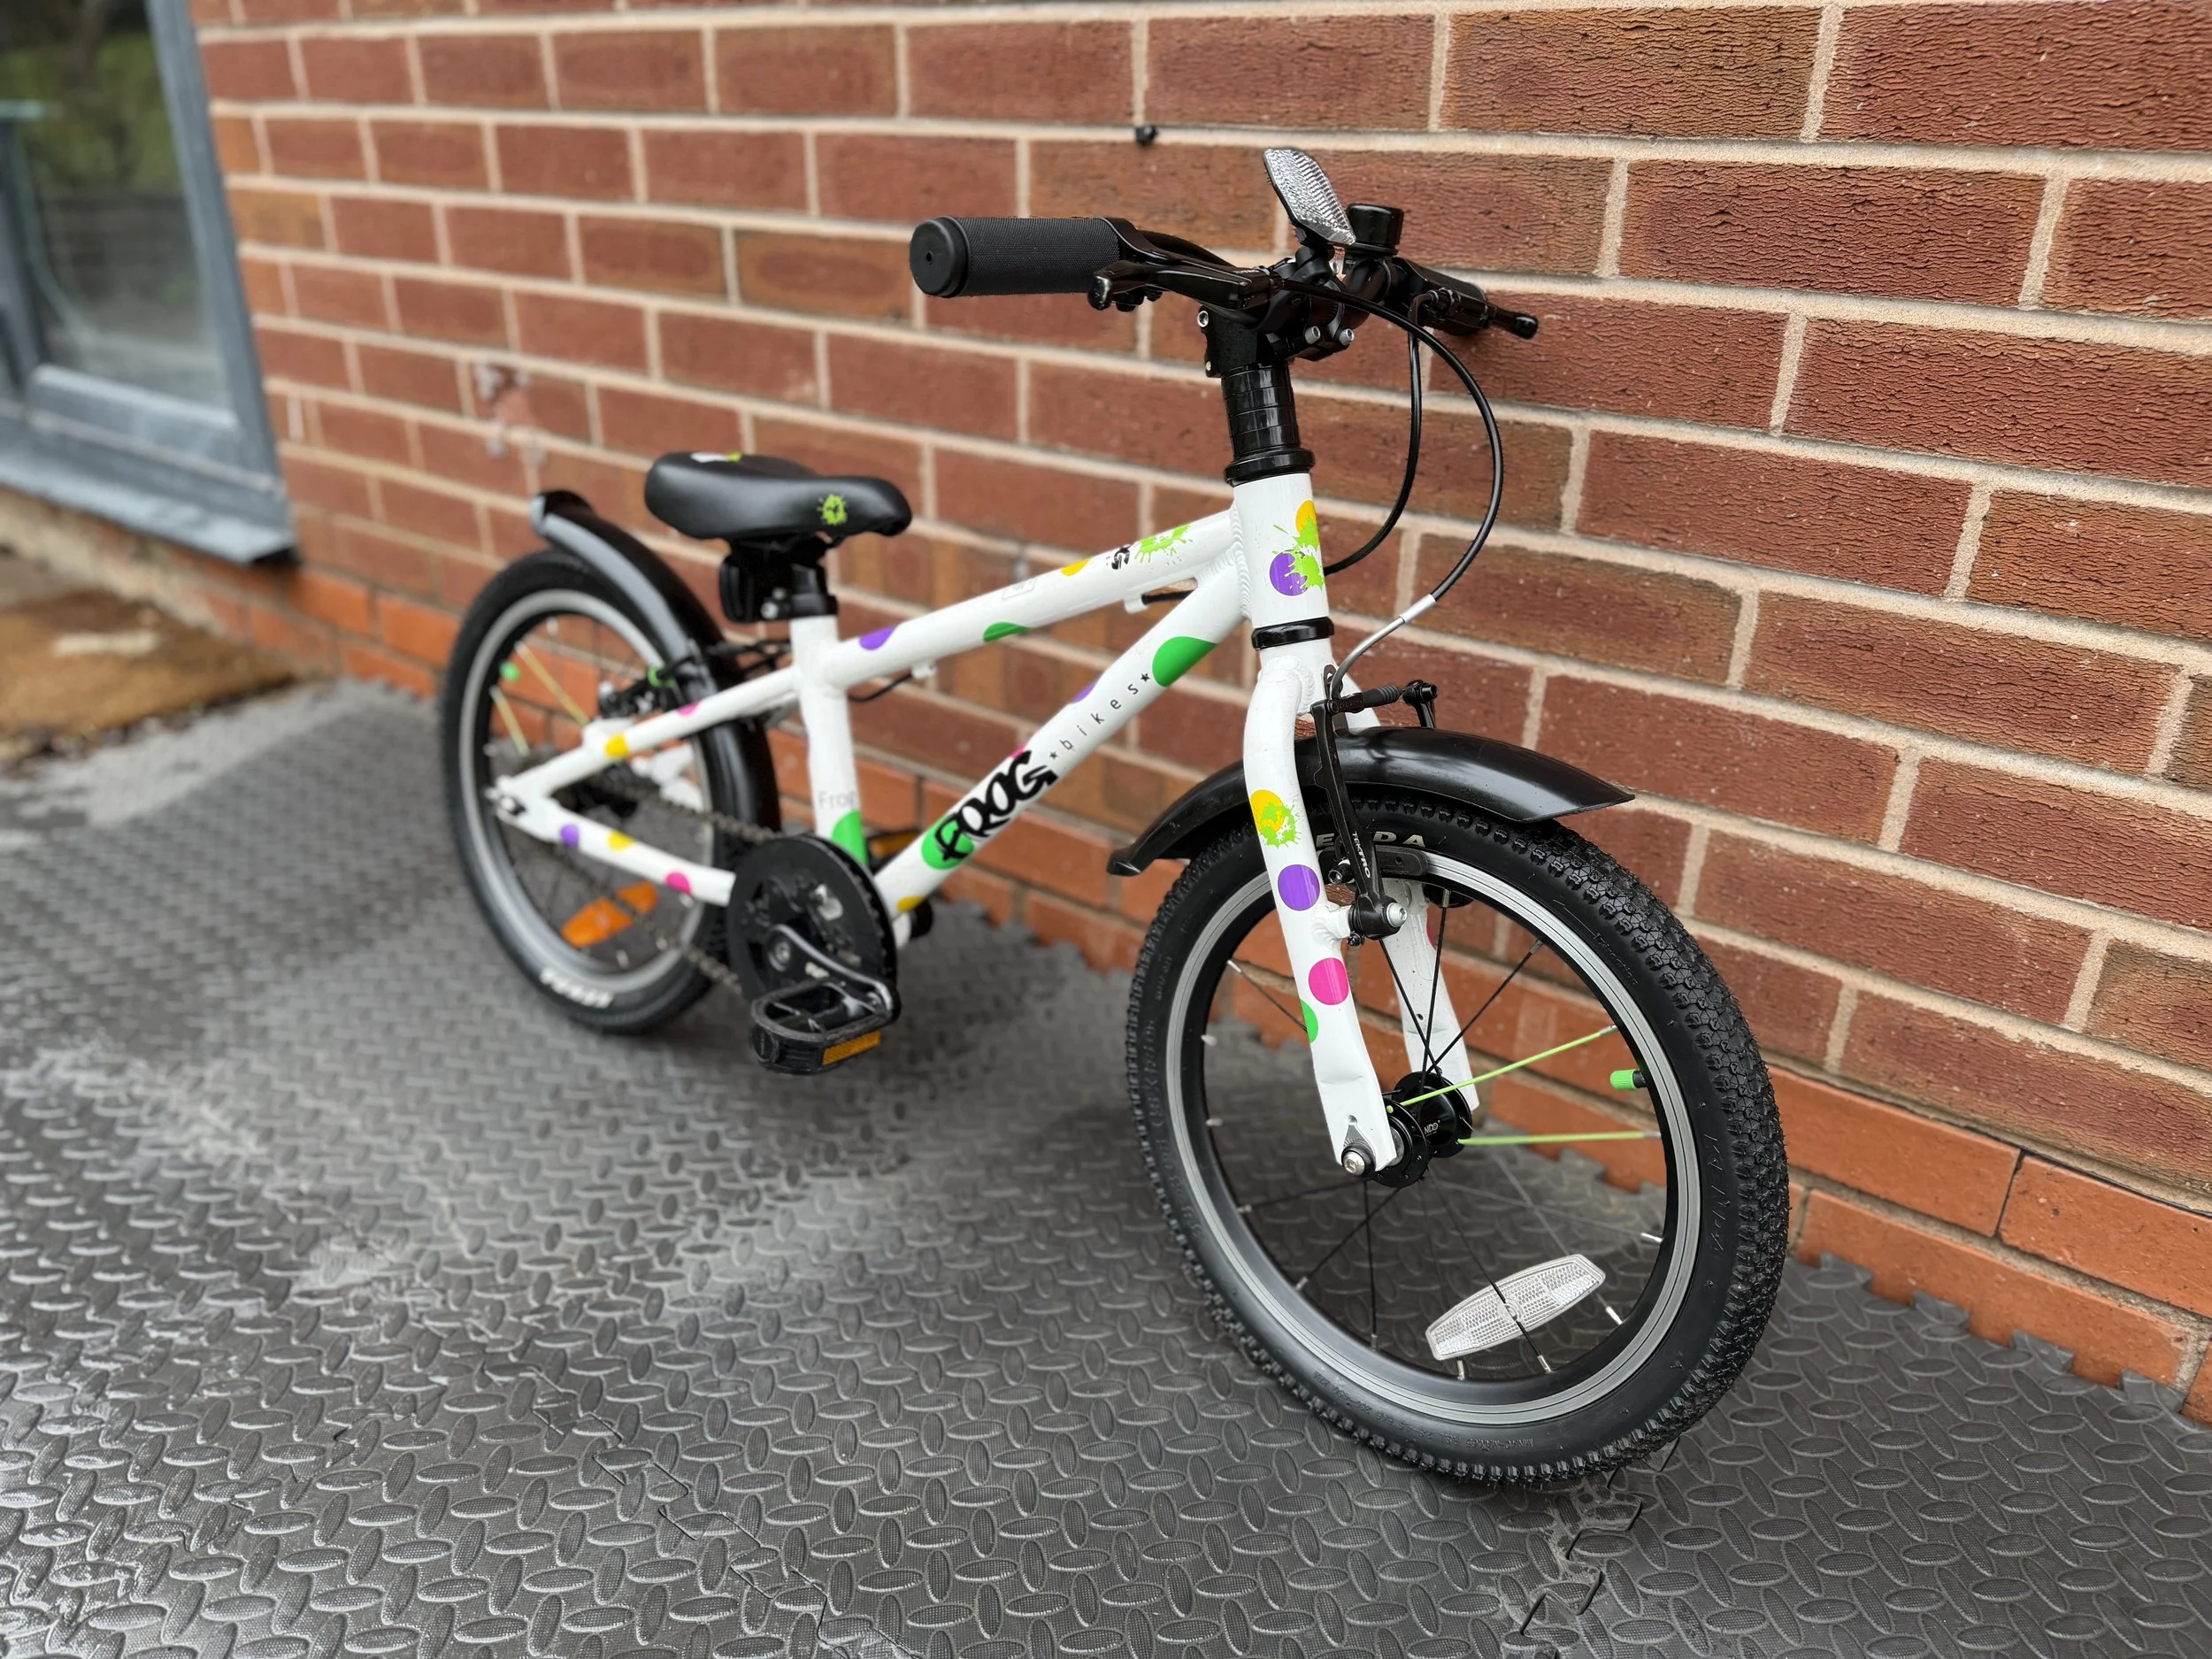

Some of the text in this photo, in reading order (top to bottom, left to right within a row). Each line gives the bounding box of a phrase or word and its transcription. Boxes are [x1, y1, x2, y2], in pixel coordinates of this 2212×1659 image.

[934, 683, 1140, 862] FROG bikes
[1352, 830, 1371, 879] TEKTRO
